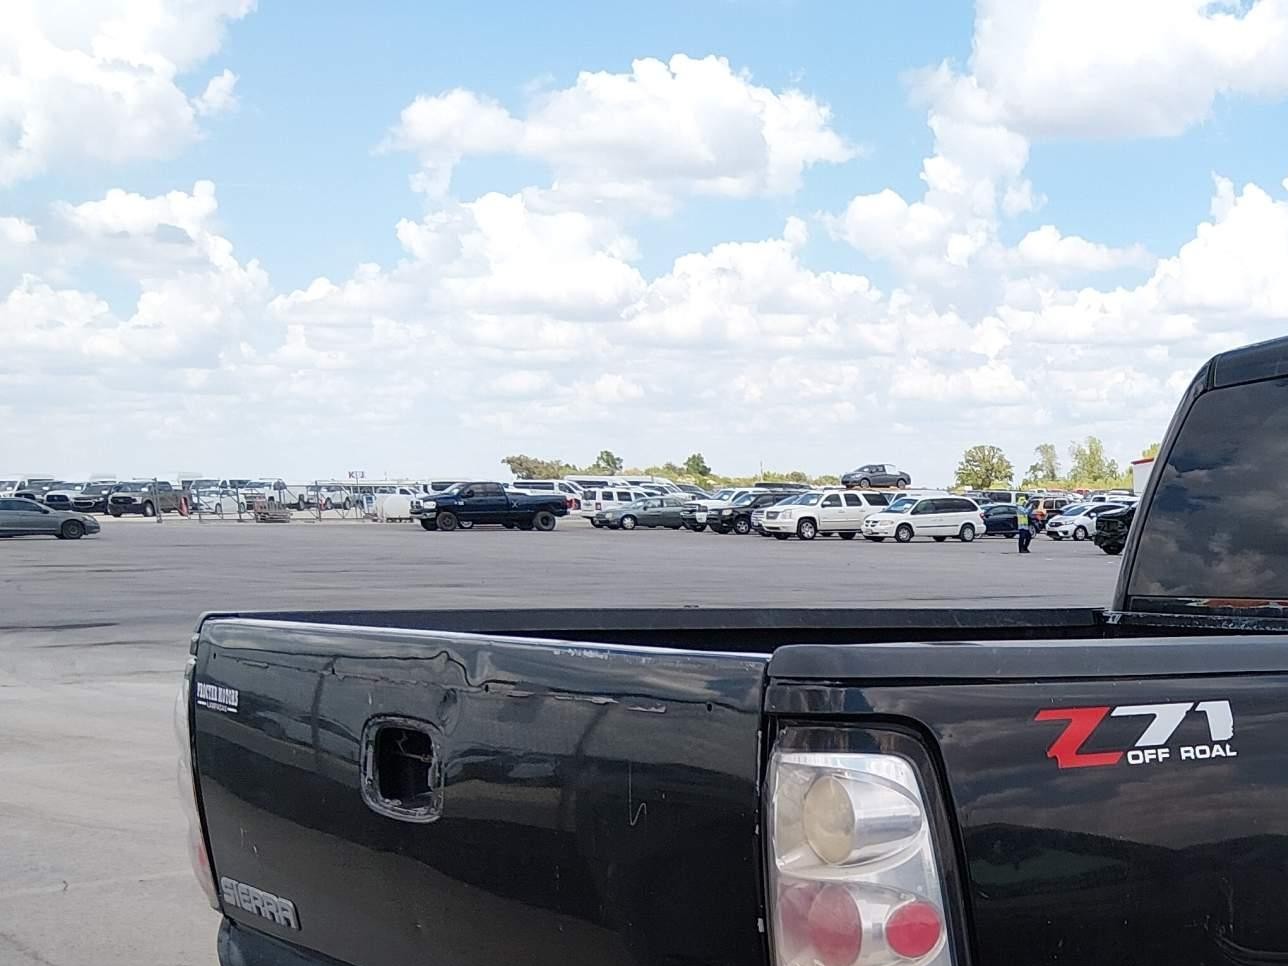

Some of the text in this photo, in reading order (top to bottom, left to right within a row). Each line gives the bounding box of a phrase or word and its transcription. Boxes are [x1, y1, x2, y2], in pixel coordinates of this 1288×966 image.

[1034, 700, 1235, 769] Z71
[1127, 747, 1170, 765] OFF
[221, 876, 297, 930] SIERRA
